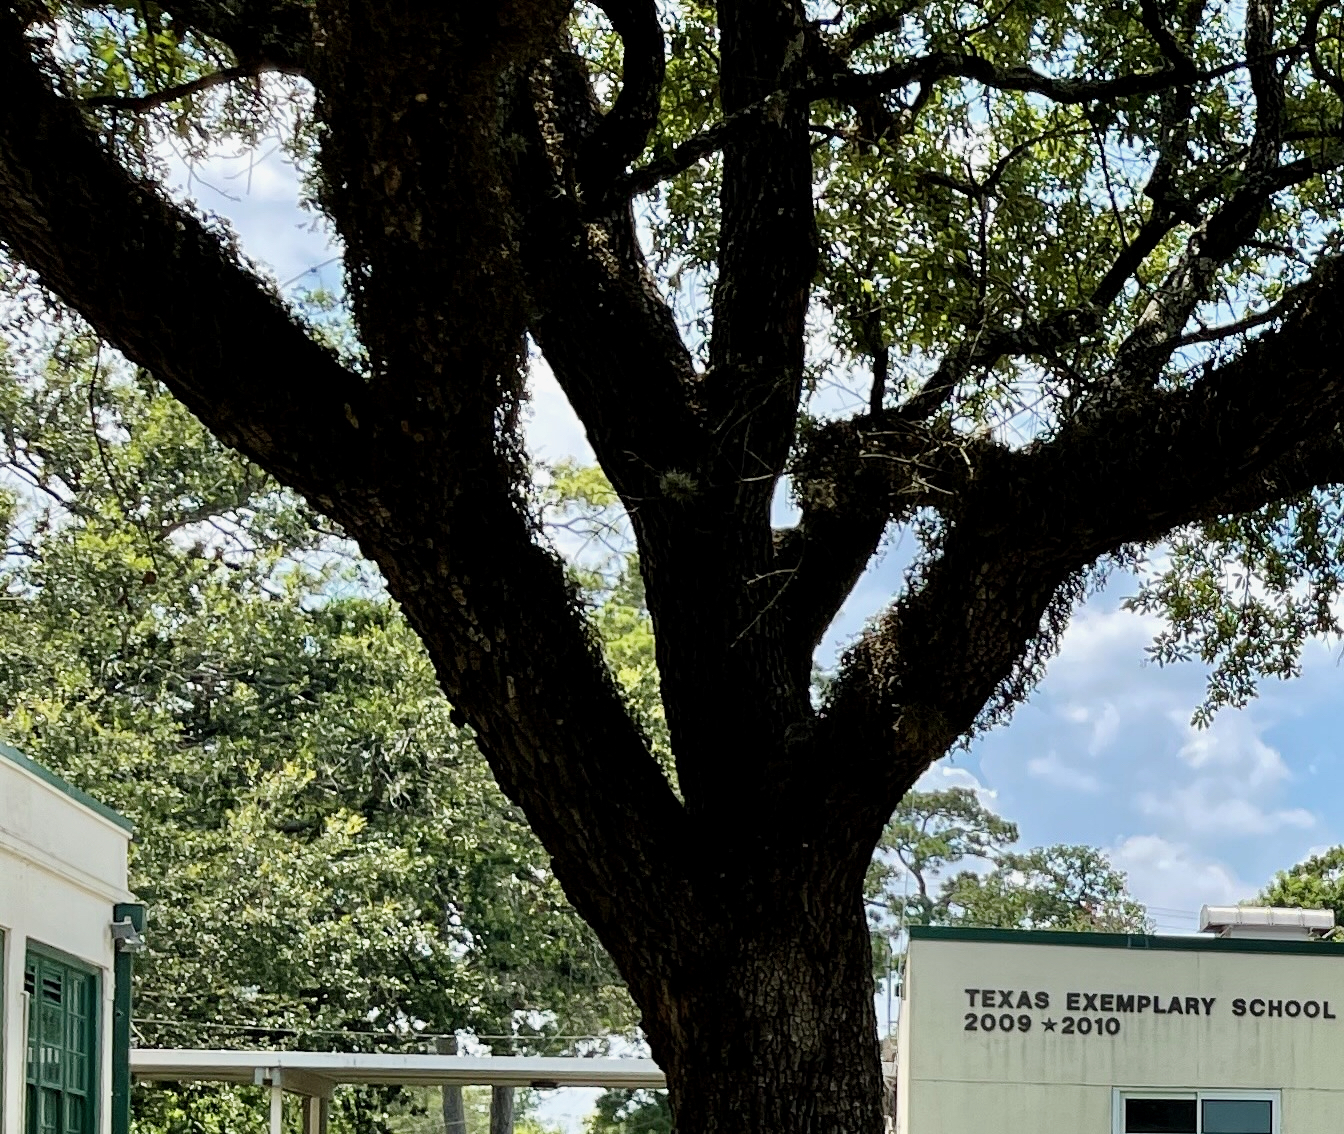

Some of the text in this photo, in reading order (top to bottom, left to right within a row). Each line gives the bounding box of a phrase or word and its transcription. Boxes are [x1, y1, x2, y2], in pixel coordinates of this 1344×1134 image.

[964, 989, 1337, 1019] TEXAS EXEMPLARY SCHOOL
[964, 1013, 1121, 1036] 2009 2010
